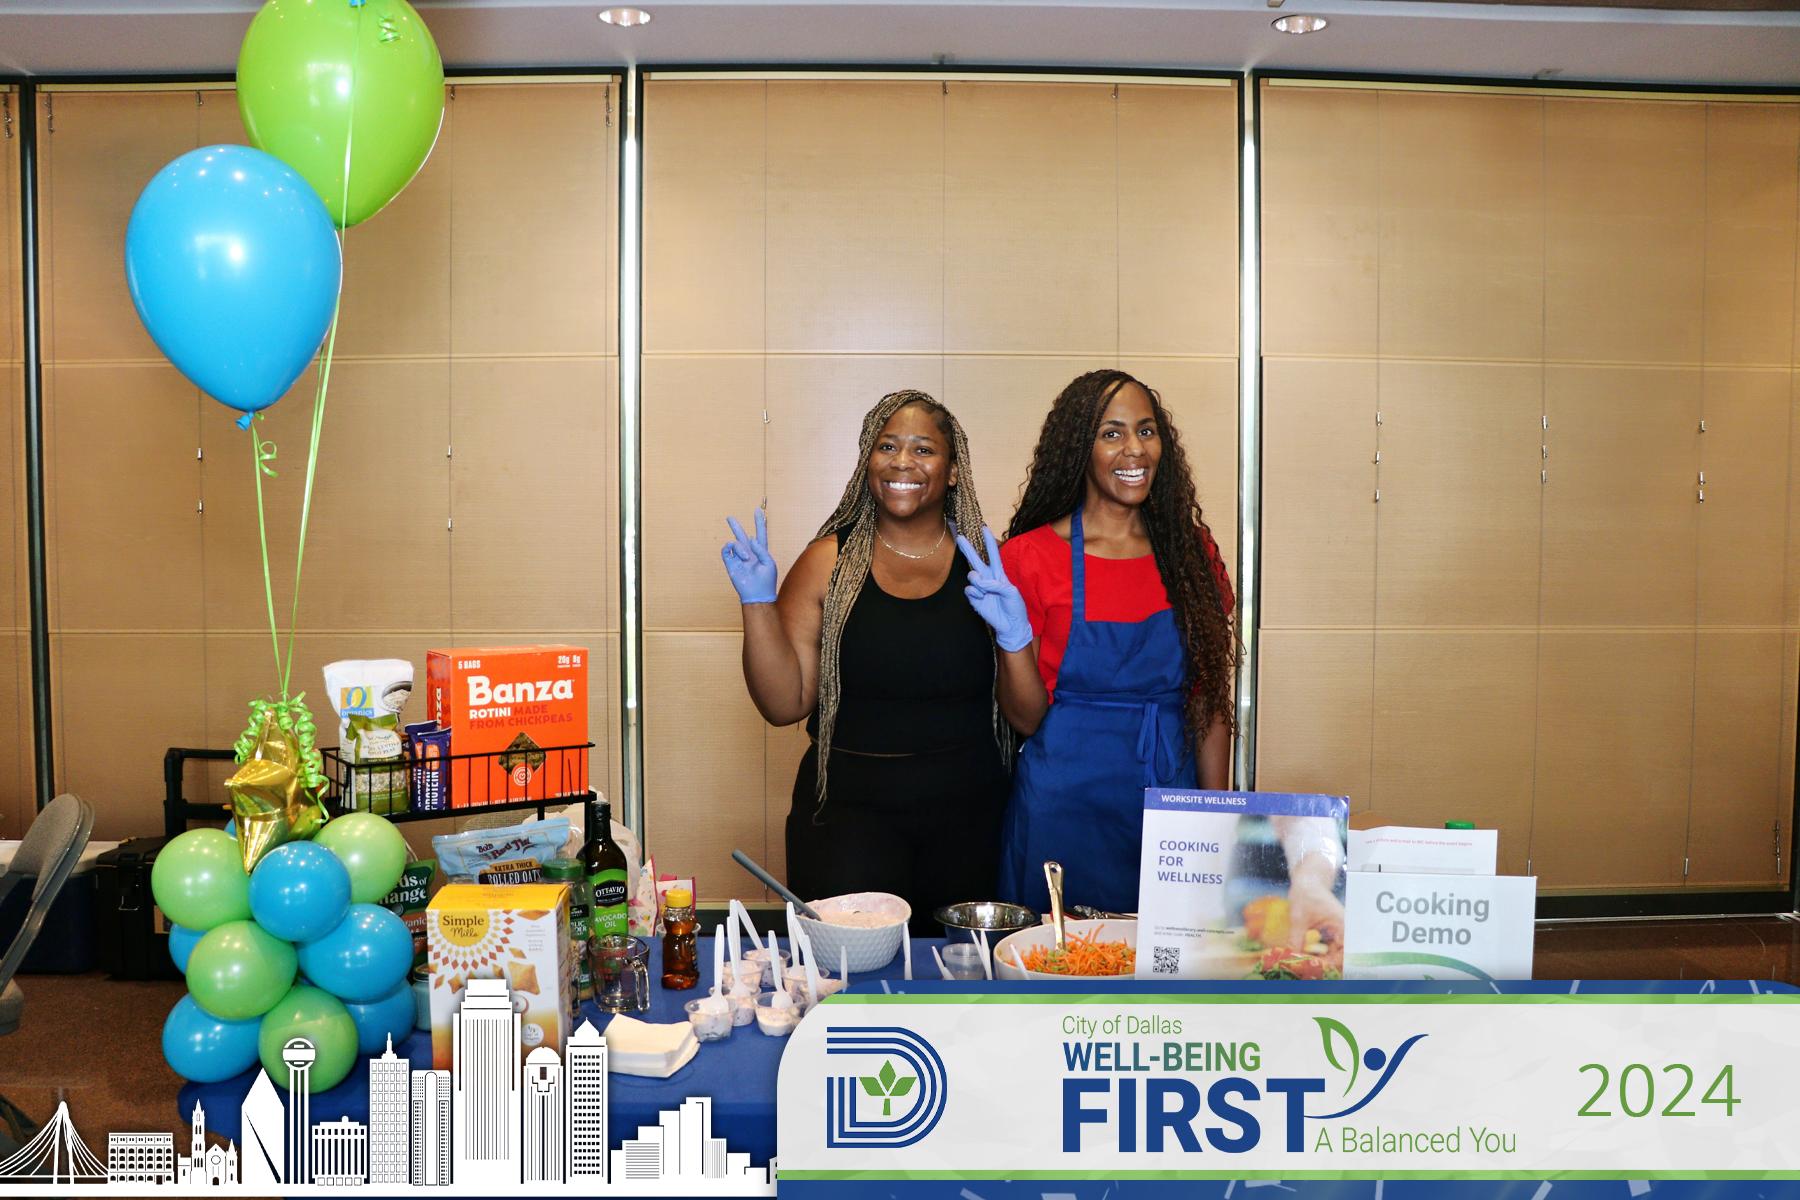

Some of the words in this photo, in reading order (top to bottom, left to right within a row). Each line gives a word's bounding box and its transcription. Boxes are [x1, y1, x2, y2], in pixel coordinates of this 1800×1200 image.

[458, 661, 463, 669] 5
[464, 660, 481, 669] BAGS
[467, 675, 575, 706] Banza
[469, 707, 511, 719] ROTINI
[513, 704, 548, 716] MADE
[469, 719, 505, 730] FROM
[507, 713, 573, 728] CHICKPEAS
[1161, 795, 1203, 804] WORKSITE
[1204, 796, 1247, 806] WELLNESS
[1159, 840, 1219, 854] COOKING
[494, 863, 515, 871] EXTRA
[516, 861, 533, 869] THICK
[1158, 855, 1184, 867] FOR
[487, 871, 520, 885] ROLLED
[1157, 871, 1223, 885] WELLNESS
[595, 886, 625, 898] OTTAVIO
[1376, 891, 1490, 923] Cooking
[442, 915, 485, 929] Simple
[594, 913, 627, 923] AVOCADO
[451, 926, 479, 938] Mills
[1392, 920, 1472, 945] Demo
